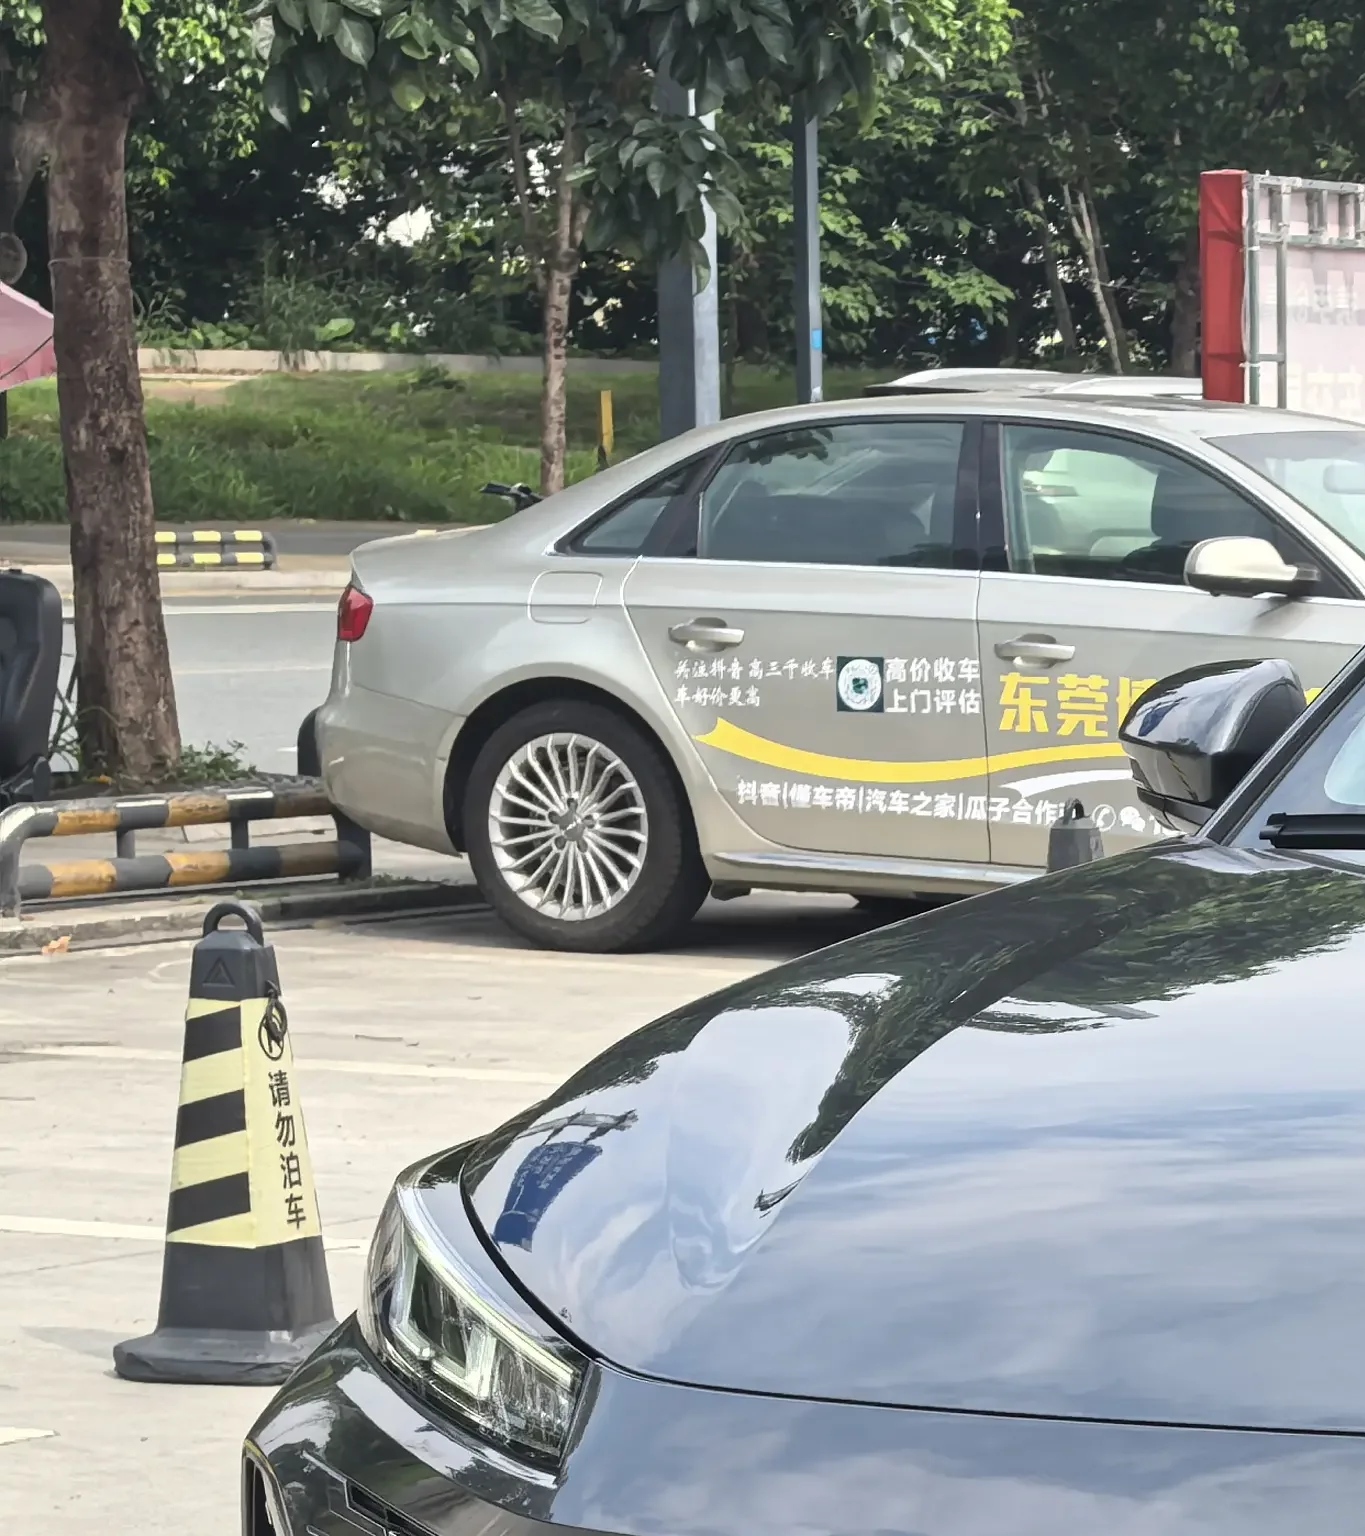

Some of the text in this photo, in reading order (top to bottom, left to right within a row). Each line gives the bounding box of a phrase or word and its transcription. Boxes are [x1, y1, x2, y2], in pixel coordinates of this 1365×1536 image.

[885, 657, 981, 683] 高价收车
[885, 688, 981, 714] 上门评估
[268, 1069, 307, 1230] 请勿泊车
